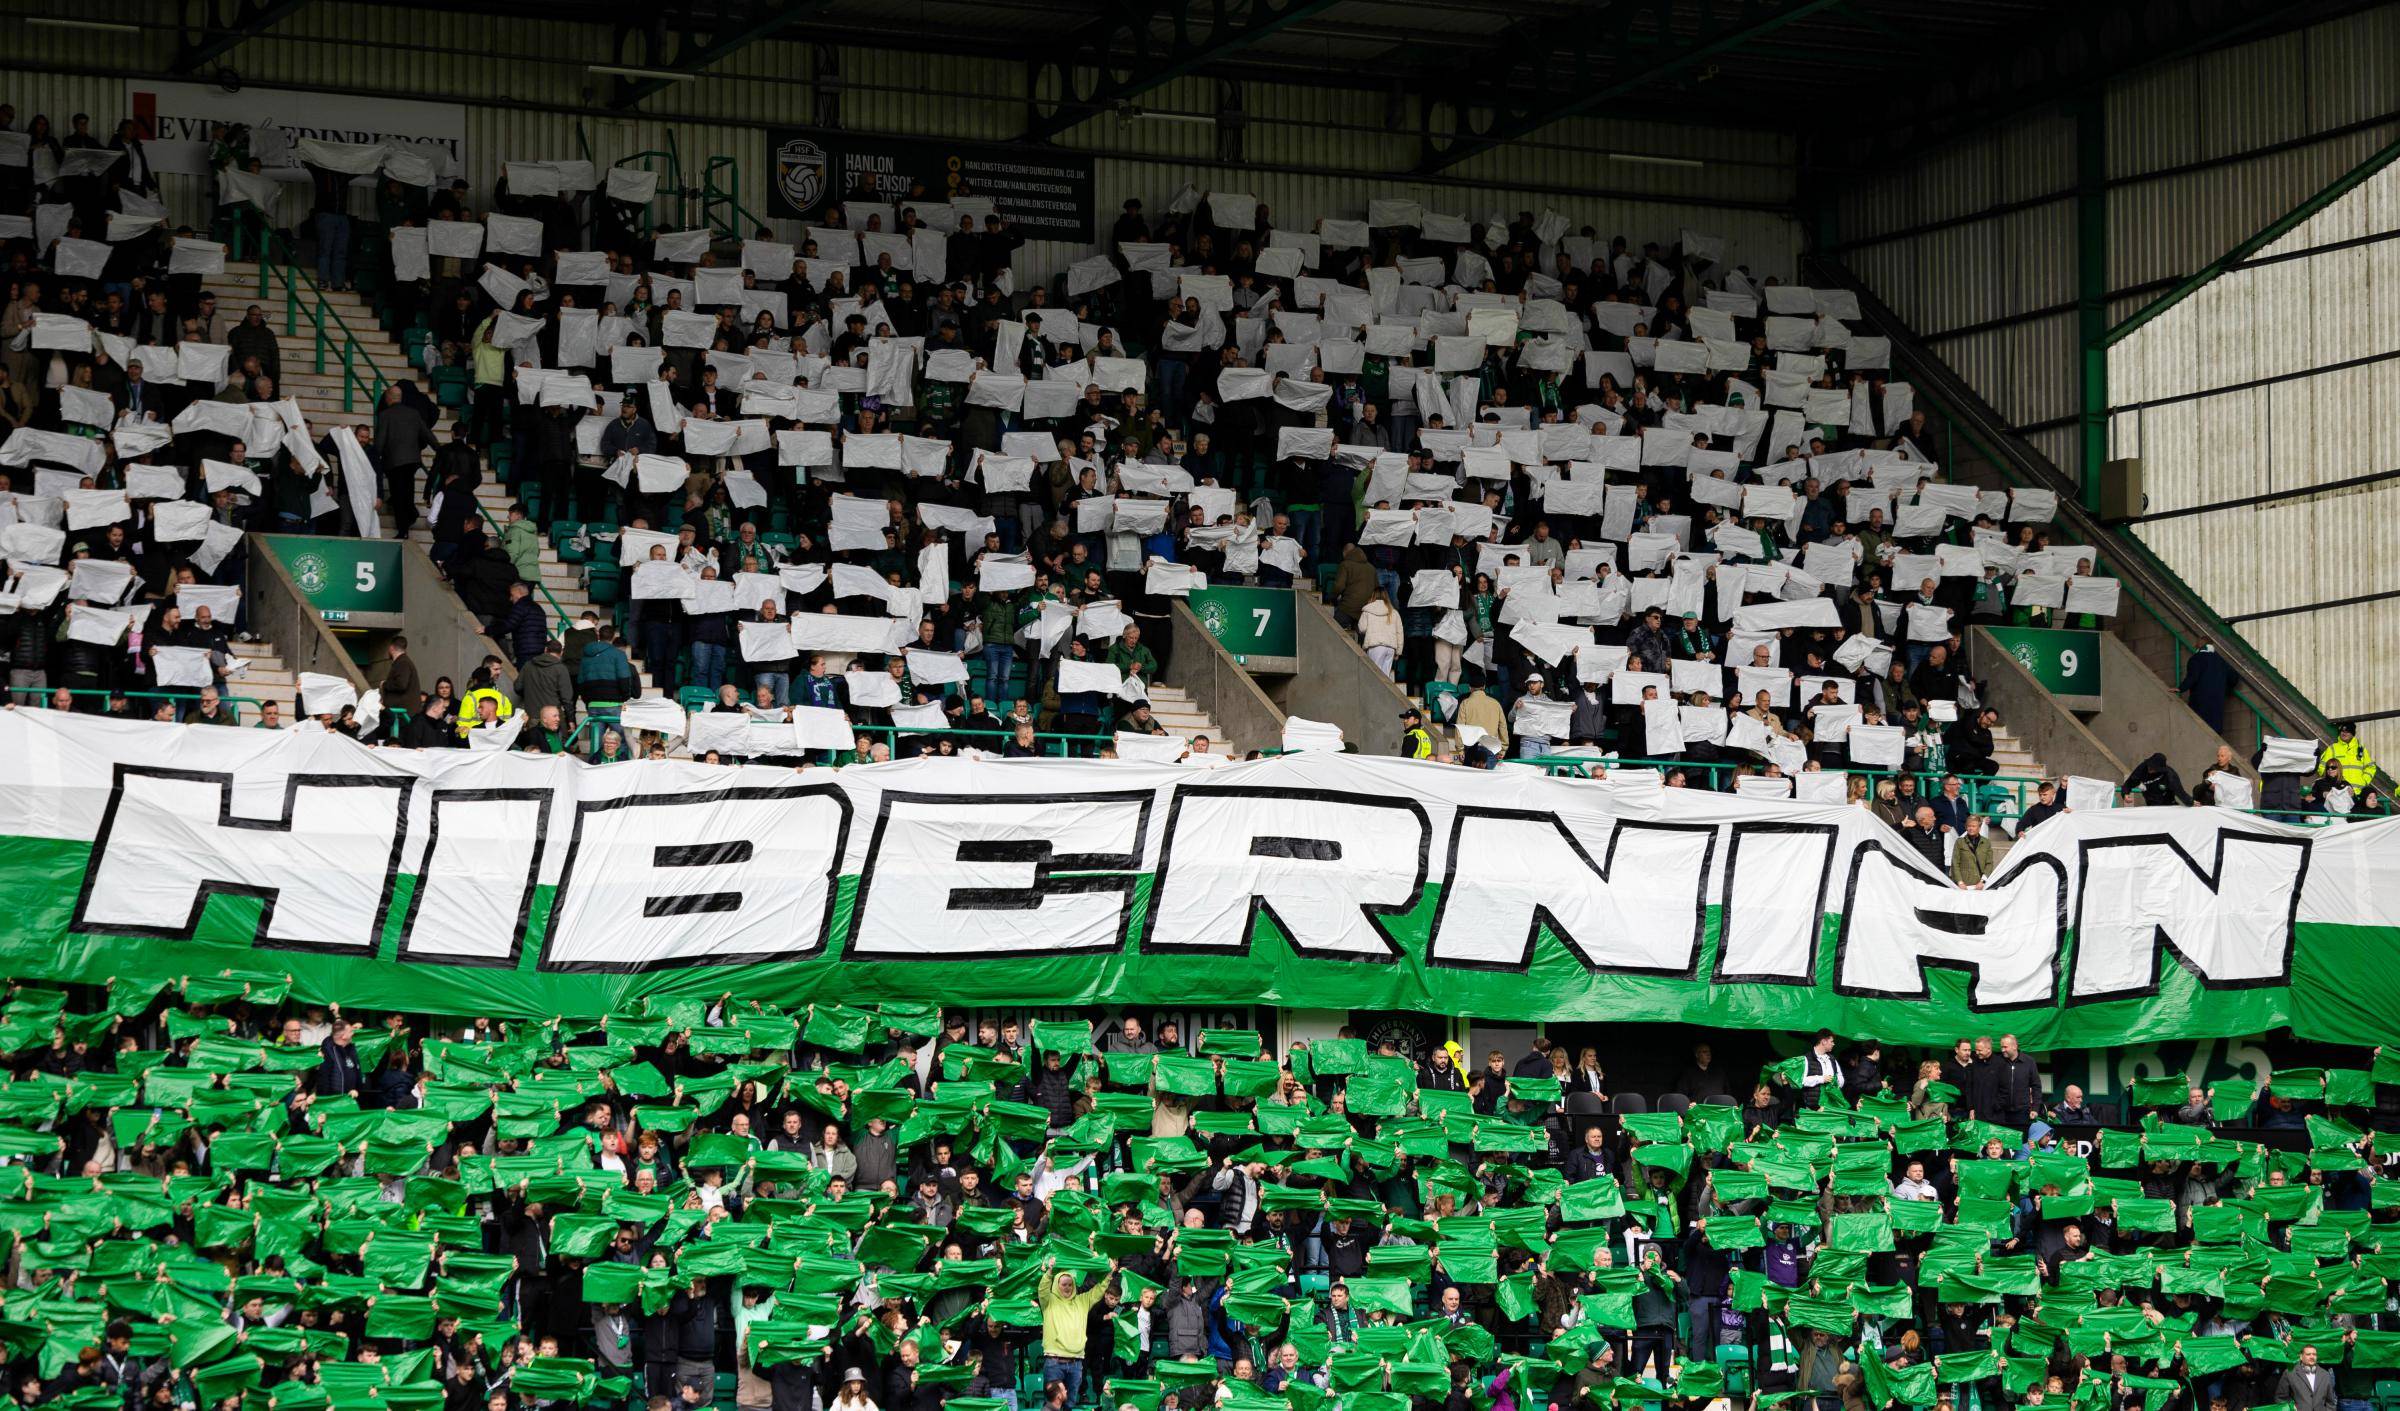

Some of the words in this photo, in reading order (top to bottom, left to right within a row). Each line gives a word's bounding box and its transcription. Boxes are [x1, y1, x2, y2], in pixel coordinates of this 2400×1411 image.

[845, 153, 894, 173] HANLON
[965, 160, 1086, 180] HANLONSTEVENSONFOUNDATION.CO.UK
[845, 172, 915, 193] STENSON
[355, 561, 376, 592] 5
[1252, 608, 1271, 637] 7
[2060, 649, 2078, 677] 9
[68, 762, 2313, 1012] HIBERNIAN
[1371, 1020, 1424, 1043] HIBERNIAN
